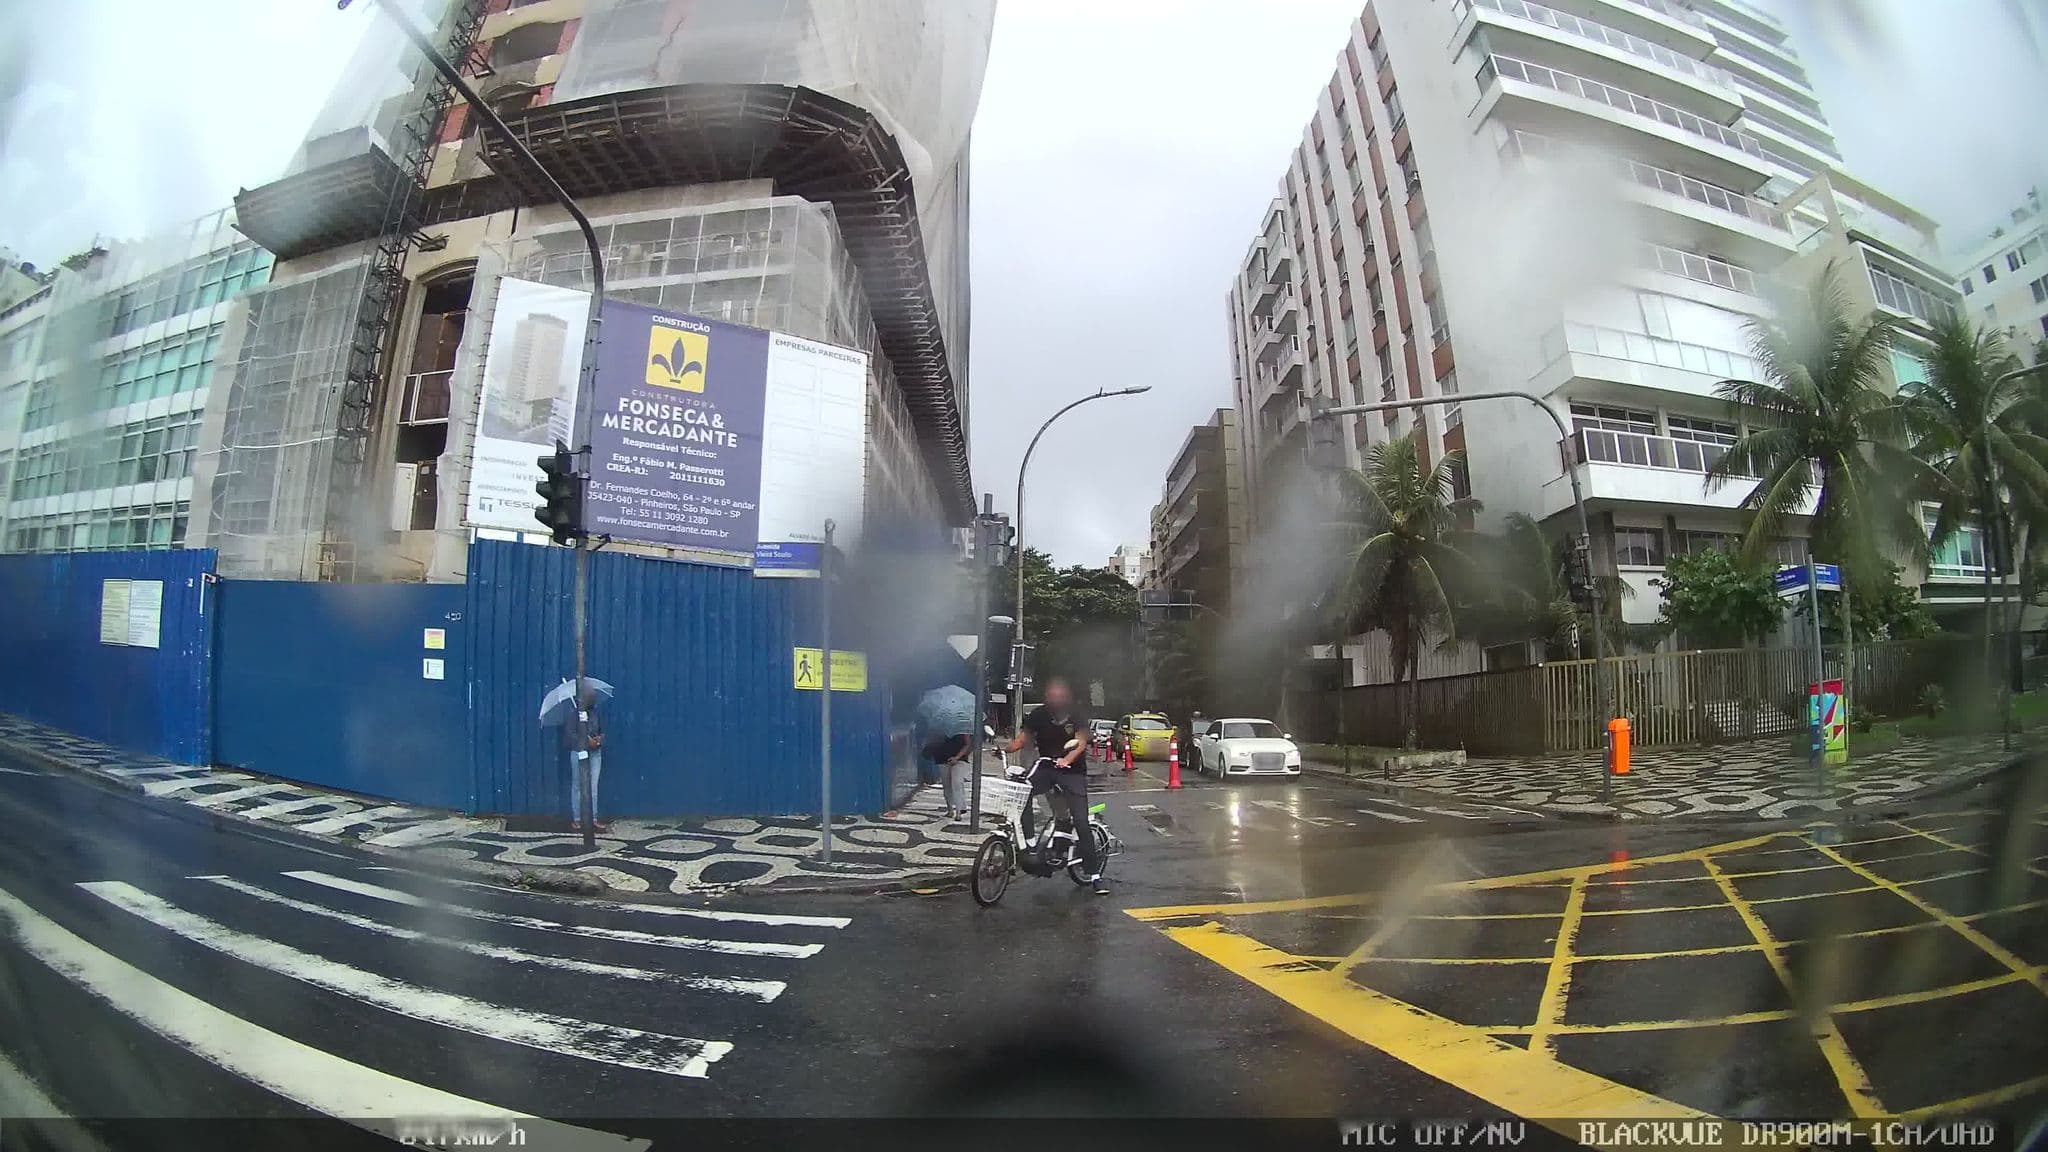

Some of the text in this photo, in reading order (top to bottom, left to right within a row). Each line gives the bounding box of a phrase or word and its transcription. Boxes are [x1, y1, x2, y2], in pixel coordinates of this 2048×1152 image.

[652, 314, 711, 333] CONSTRUÇÃO
[775, 338, 862, 365] EMPRESAS PARCEIRAS
[631, 389, 716, 410] CONSTRUTORA
[619, 398, 725, 429] FONSECA &
[602, 412, 738, 448] MERCADANTE
[623, 437, 717, 459] Responsável Técnico:
[606, 463, 649, 476] CREA-RJ:
[640, 456, 665, 468] Fábio
[666, 460, 677, 470] M.
[590, 480, 602, 489] Dr.
[605, 482, 649, 496] Fernandes
[650, 488, 680, 502] Coelho,
[682, 492, 694, 501] 64
[732, 500, 756, 511] andar
[620, 506, 637, 516] Tel:
[639, 508, 650, 518] 55
[652, 510, 662, 519] 11
[664, 512, 686, 522] 3092
[641, 498, 681, 512] Pinheiros,
[682, 503, 698, 514] São
[700, 506, 722, 517] Paulo
[730, 510, 741, 518] SP
[596, 515, 731, 538] www.fonsecamercadante.com.br
